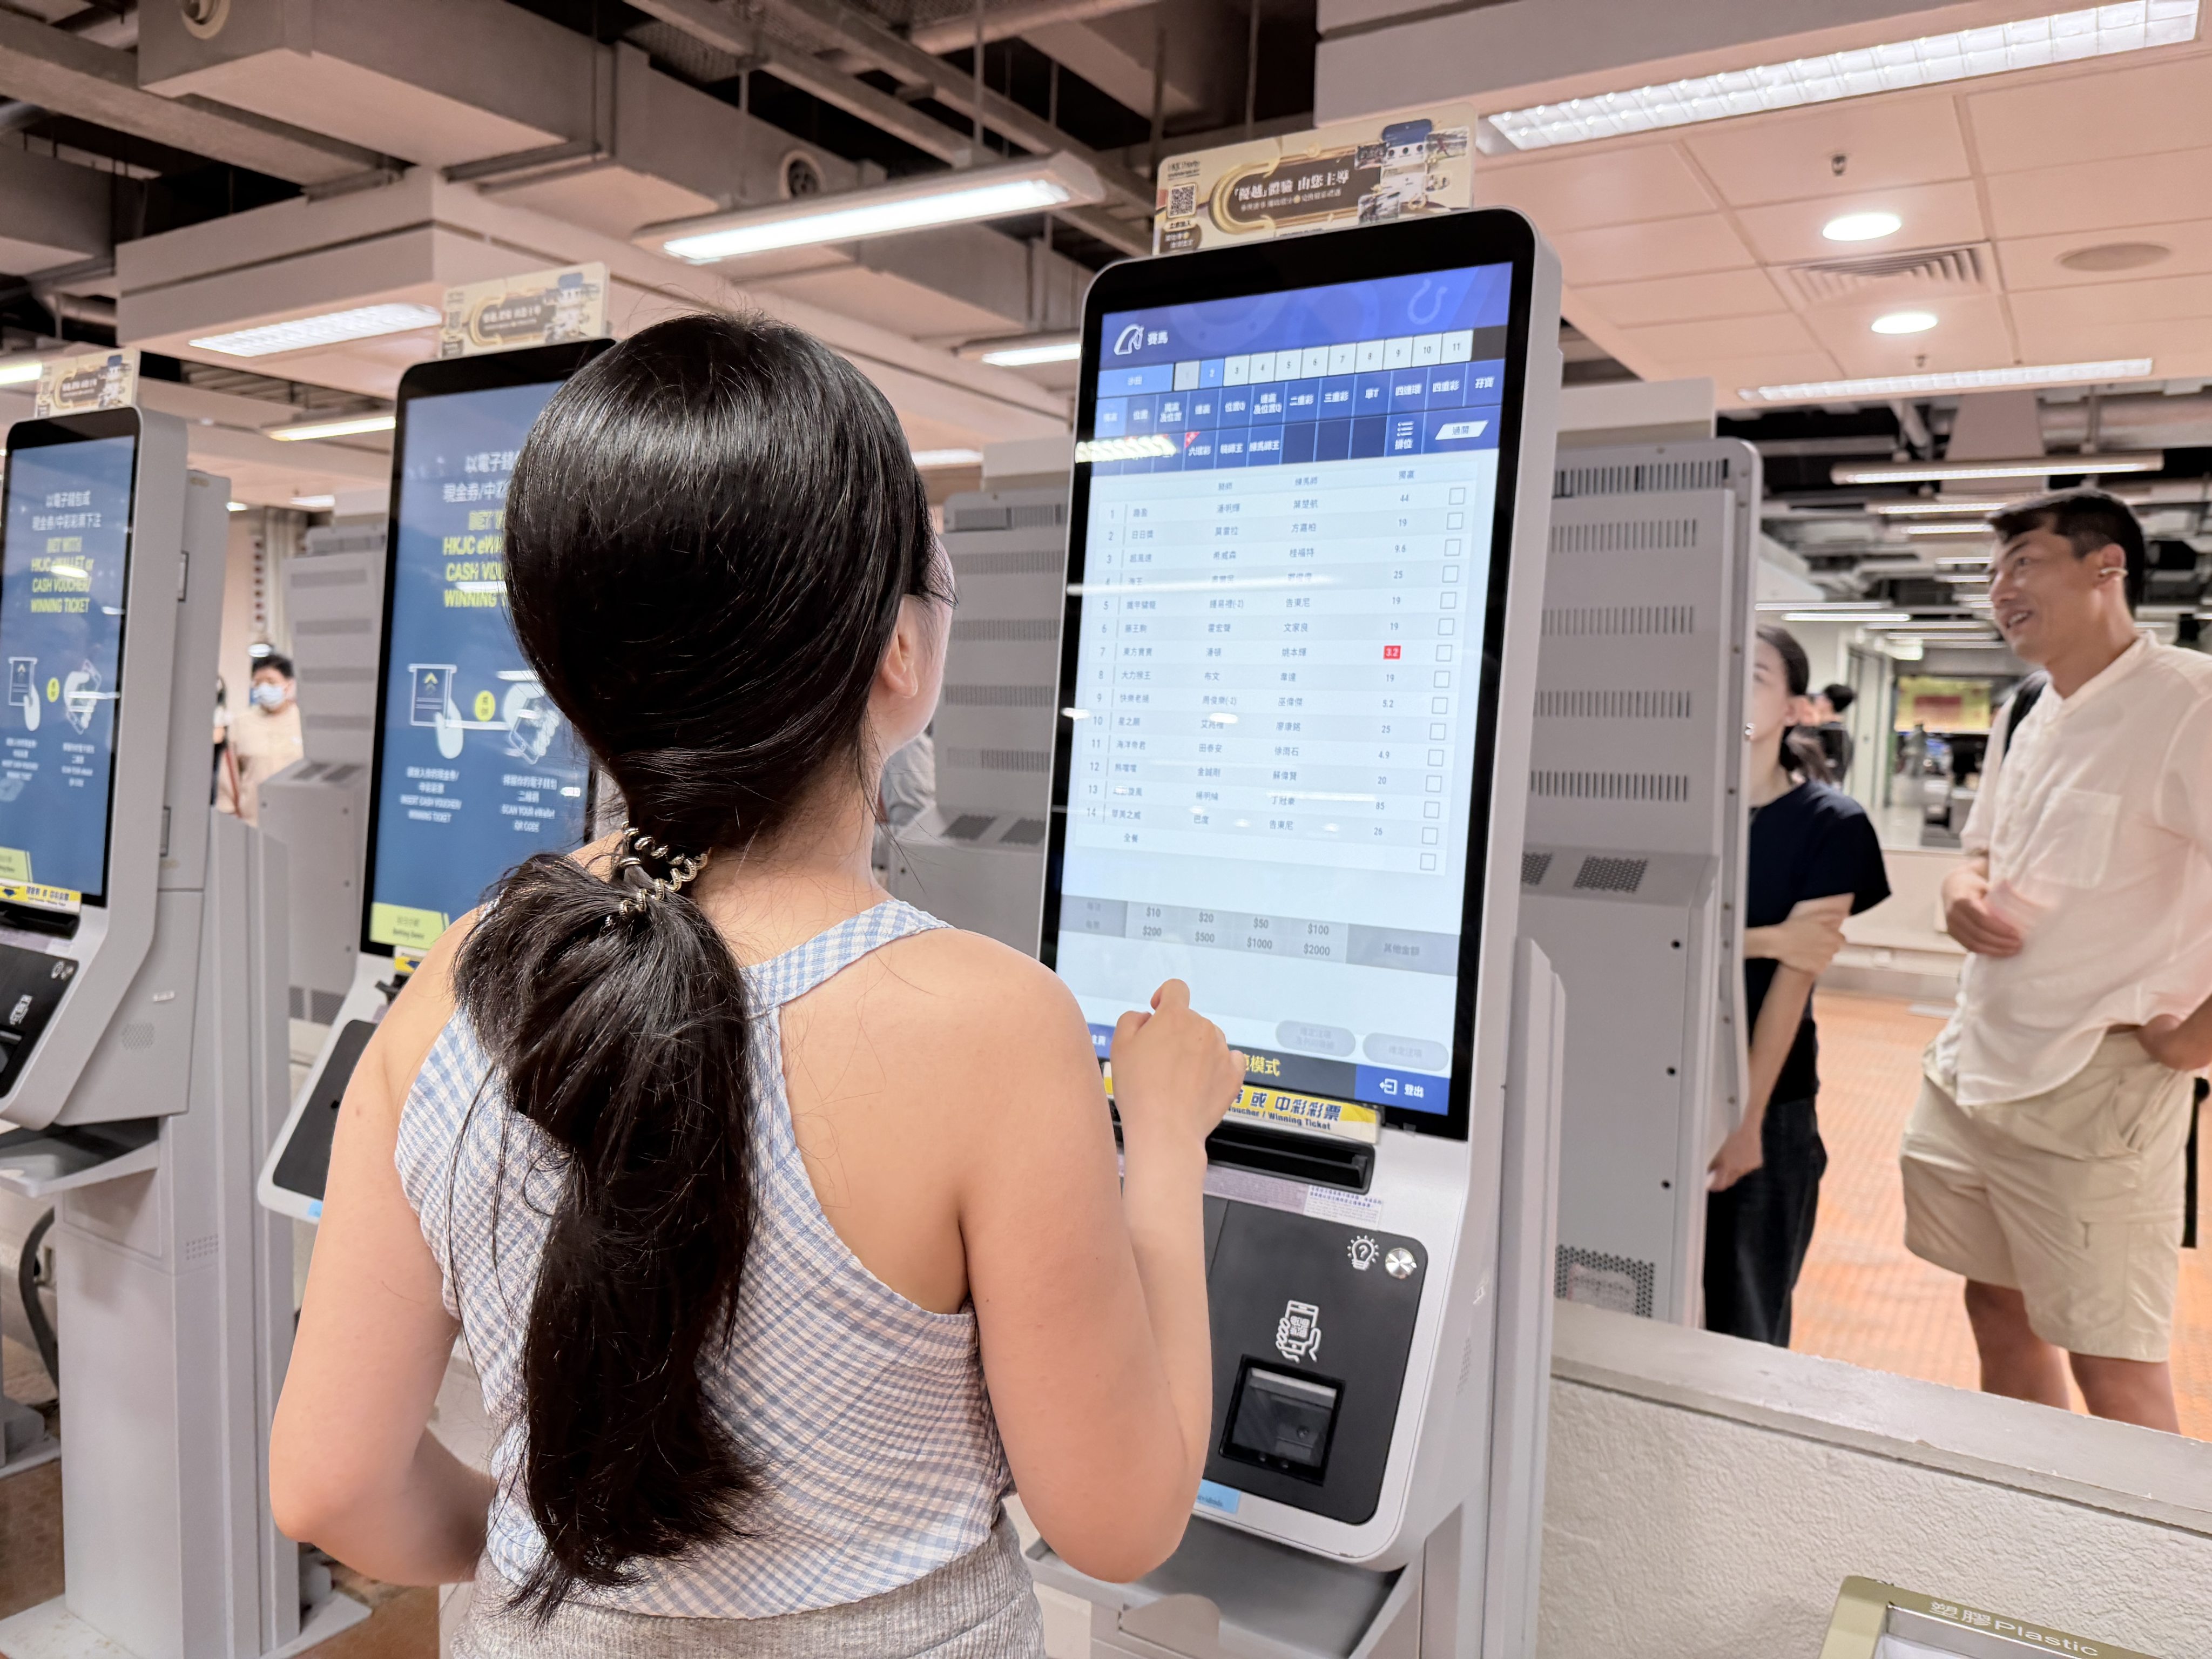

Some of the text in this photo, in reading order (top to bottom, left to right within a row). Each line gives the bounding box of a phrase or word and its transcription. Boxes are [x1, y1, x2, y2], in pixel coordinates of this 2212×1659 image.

[1147, 331, 1168, 345] 賽馬
[1395, 439, 1413, 450] 排位
[465, 451, 518, 473] 以電子錢
[1108, 531, 1114, 541] 2
[1399, 518, 1407, 527] 19
[443, 536, 476, 555] HKJC
[1107, 555, 1111, 564] 3
[1395, 545, 1406, 553] 9.6
[31, 557, 51, 572] HKJC
[446, 562, 479, 581] CASH
[1393, 571, 1403, 579] 25
[32, 578, 52, 592] CASH
[64, 598, 90, 612] TICKET
[444, 589, 497, 608] WINNING
[1104, 601, 1109, 610] 5
[1286, 598, 1310, 608] 告東尼
[1102, 624, 1106, 633] 6
[1284, 623, 1308, 632] 文家良
[1100, 648, 1105, 656] 7
[1386, 649, 1398, 657] 3.2
[1098, 671, 1103, 679] 8
[1386, 674, 1394, 682] 19
[1097, 693, 1102, 702] 9
[1382, 699, 1394, 707] 5.2
[1094, 716, 1103, 725] 10
[1381, 725, 1391, 733] 25
[1092, 739, 1100, 748] 11
[1199, 744, 1222, 753] 田泰安
[1378, 751, 1390, 759] 4.9
[1090, 763, 1099, 771] 12
[1378, 777, 1386, 785] 20
[1089, 785, 1097, 794] 13
[1375, 802, 1385, 810] 85
[1087, 808, 1096, 817] 14
[1194, 815, 1209, 825] 巴度
[1269, 820, 1293, 831] 告東尼
[1374, 827, 1382, 835] 26
[1147, 907, 1329, 935] $10 $20 $50 $100
[1142, 926, 1330, 956] $200 $500 $1000 $2000
[1405, 1084, 1424, 1098] 登出
[1251, 1092, 1267, 1107] 或
[1274, 1096, 1341, 1121] 中彩彩票
[1230, 1108, 1259, 1117] oucher
[1269, 1111, 1302, 1126] Winning
[1305, 1118, 1331, 1129] Ticket
